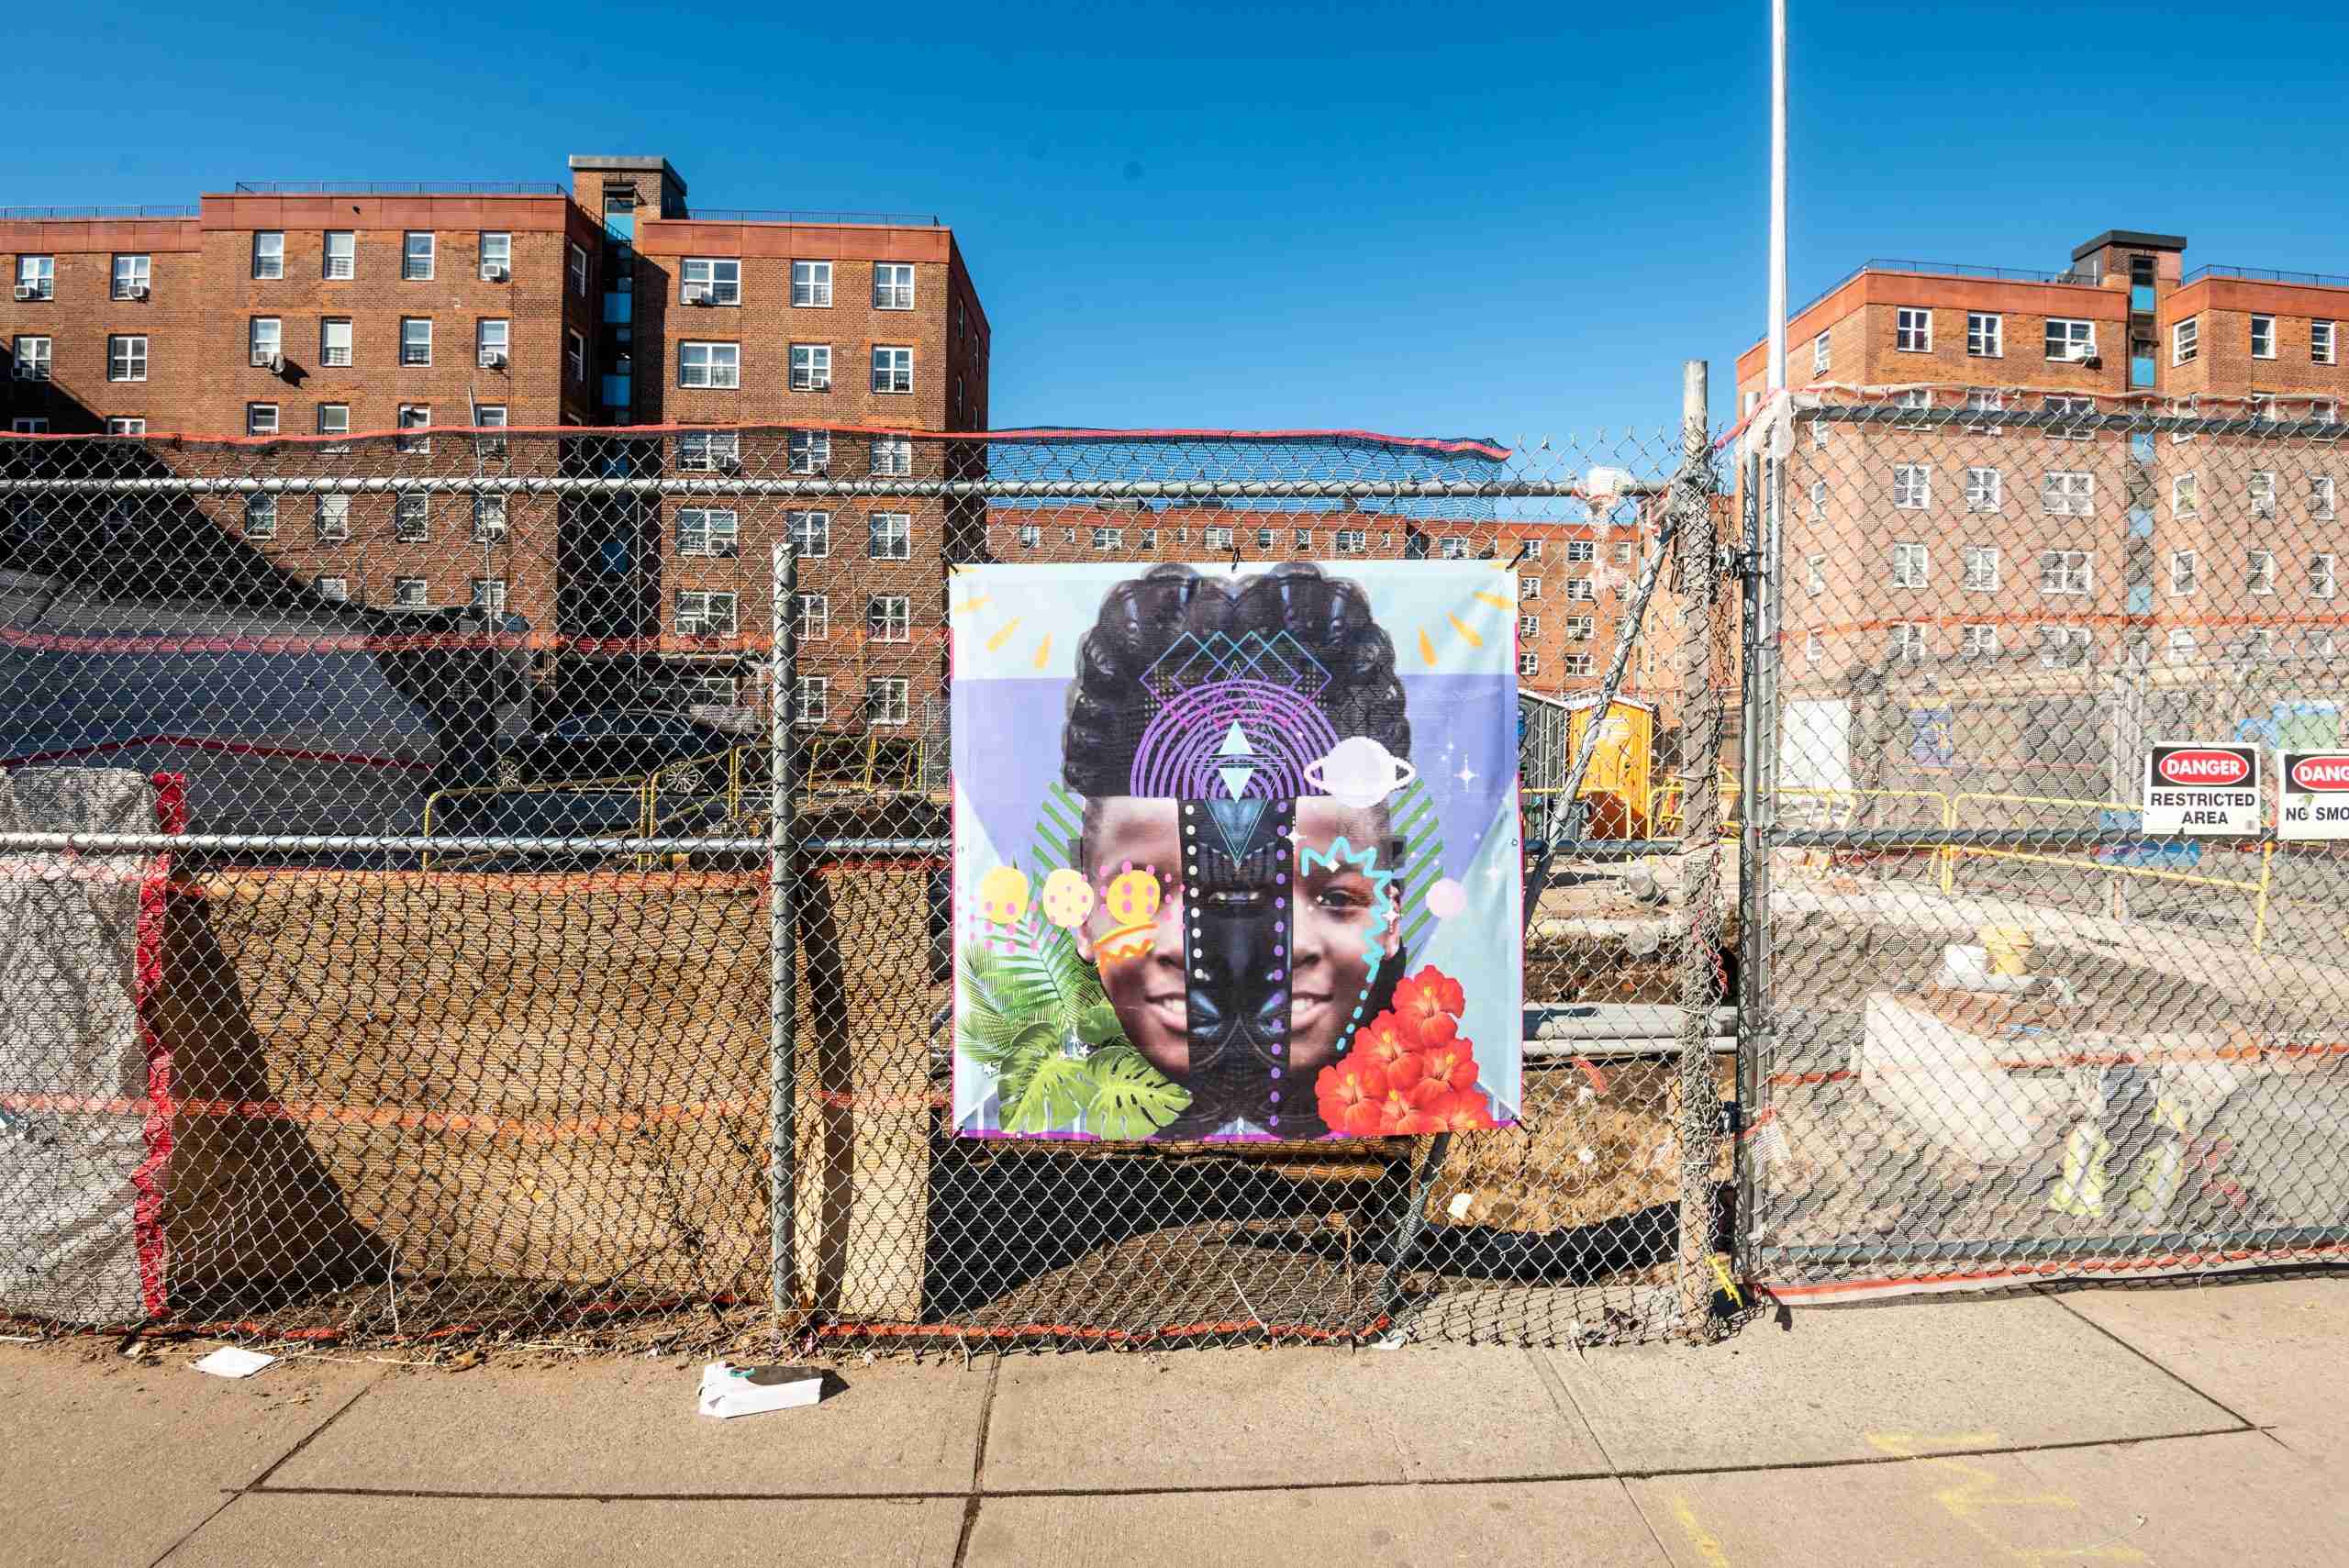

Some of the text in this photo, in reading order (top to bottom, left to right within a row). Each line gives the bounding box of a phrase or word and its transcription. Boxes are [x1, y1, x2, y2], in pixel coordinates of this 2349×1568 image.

[2166, 760, 2241, 775] DANGER
[2151, 793, 2255, 806] RESTRICTED
[2181, 811, 2228, 824] AREA
